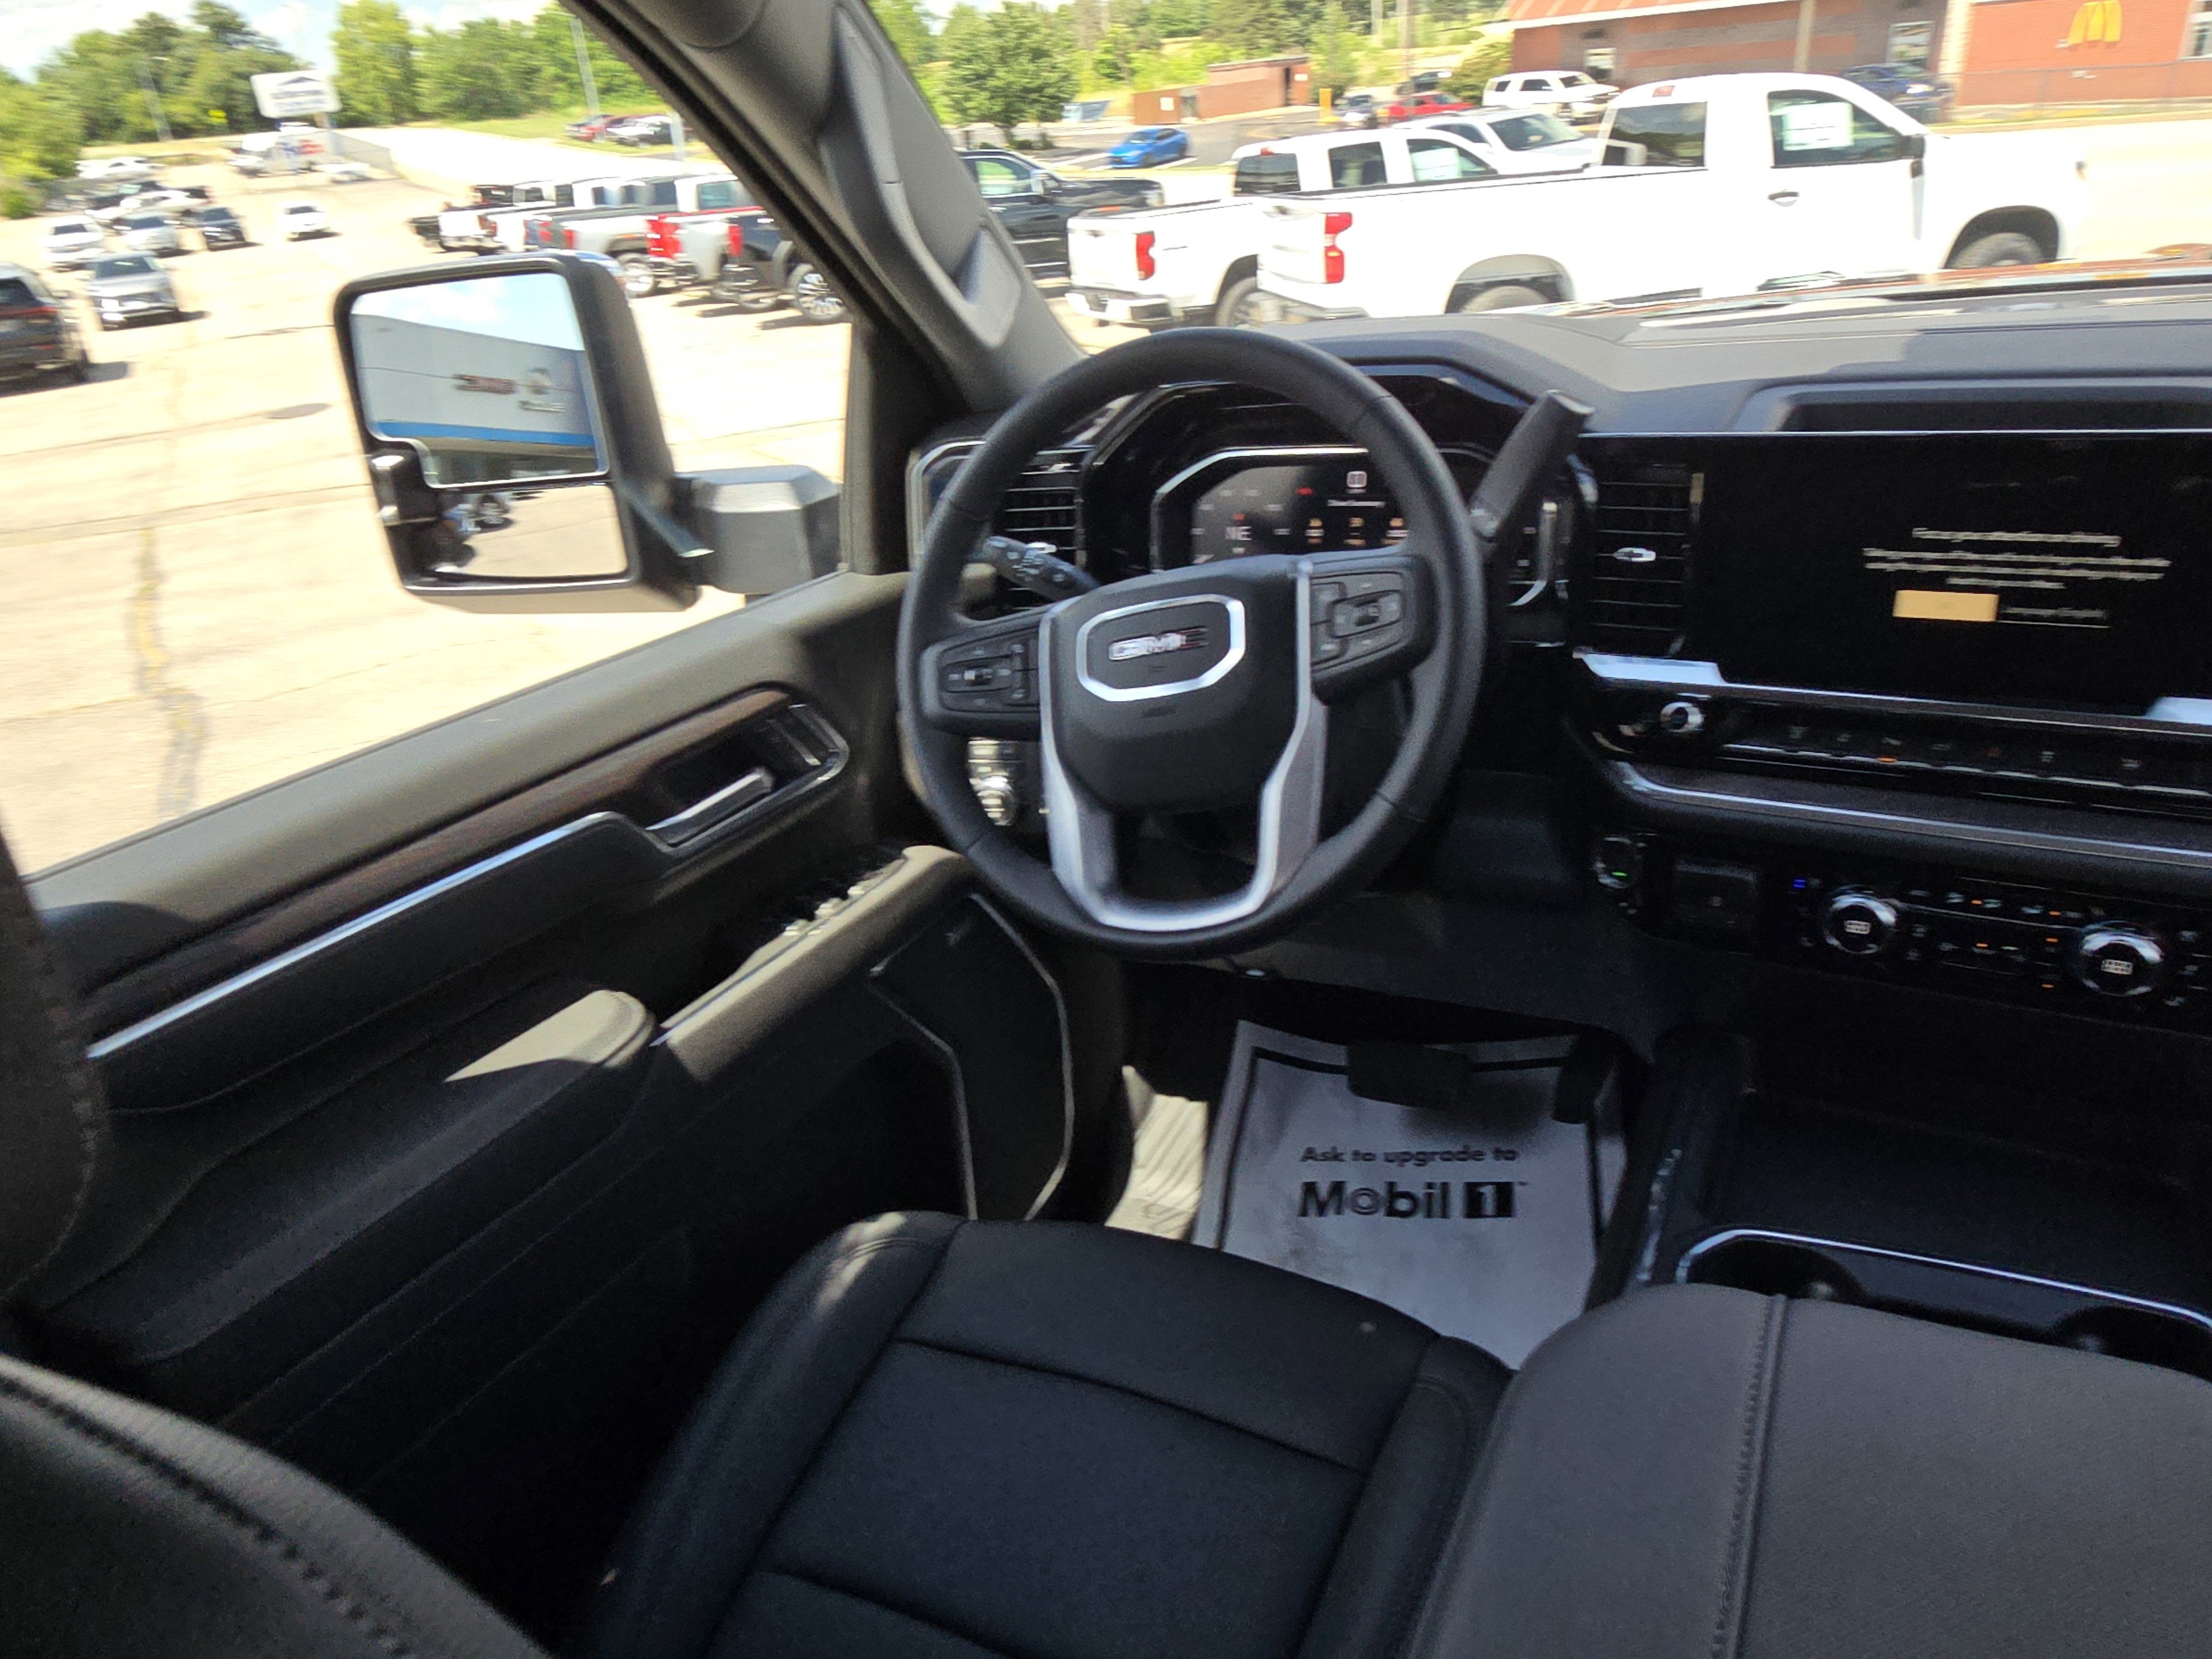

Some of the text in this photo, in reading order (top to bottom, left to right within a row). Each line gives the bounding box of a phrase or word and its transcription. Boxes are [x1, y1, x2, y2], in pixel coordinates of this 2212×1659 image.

[1301, 1145, 1519, 1167] Ask to upgrade to
[1298, 1180, 1451, 1219] Mobil
